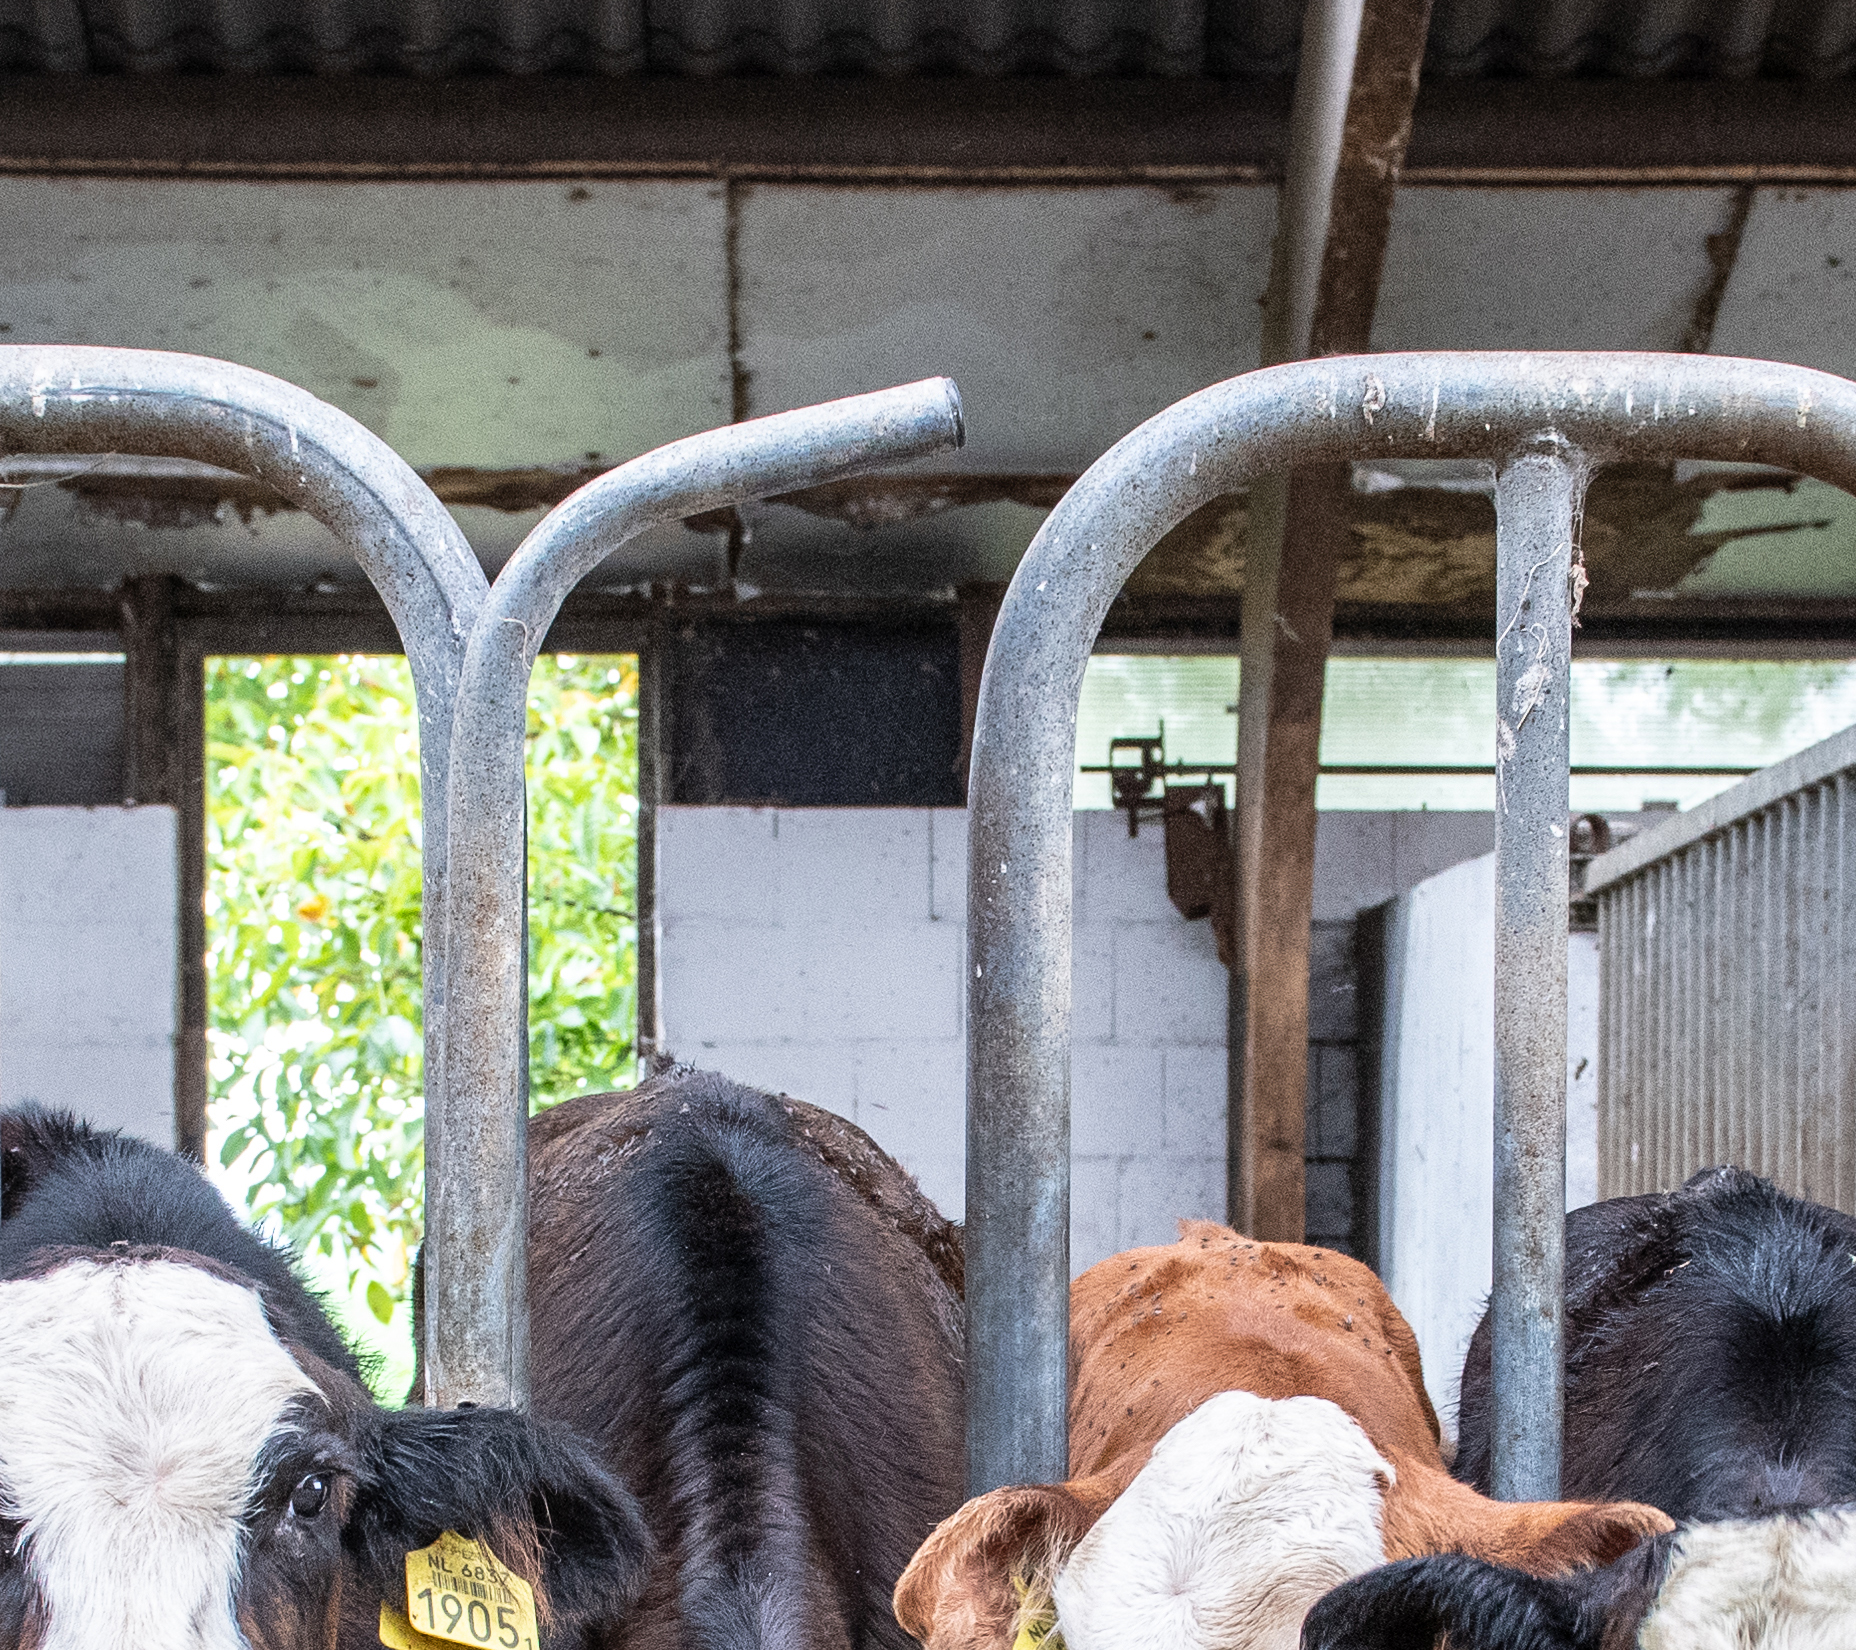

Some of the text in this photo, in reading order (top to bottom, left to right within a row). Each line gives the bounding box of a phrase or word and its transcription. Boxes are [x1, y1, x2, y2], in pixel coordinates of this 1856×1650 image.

[427, 1553, 510, 1584] NL 6837
[417, 1587, 521, 1649] 1905
